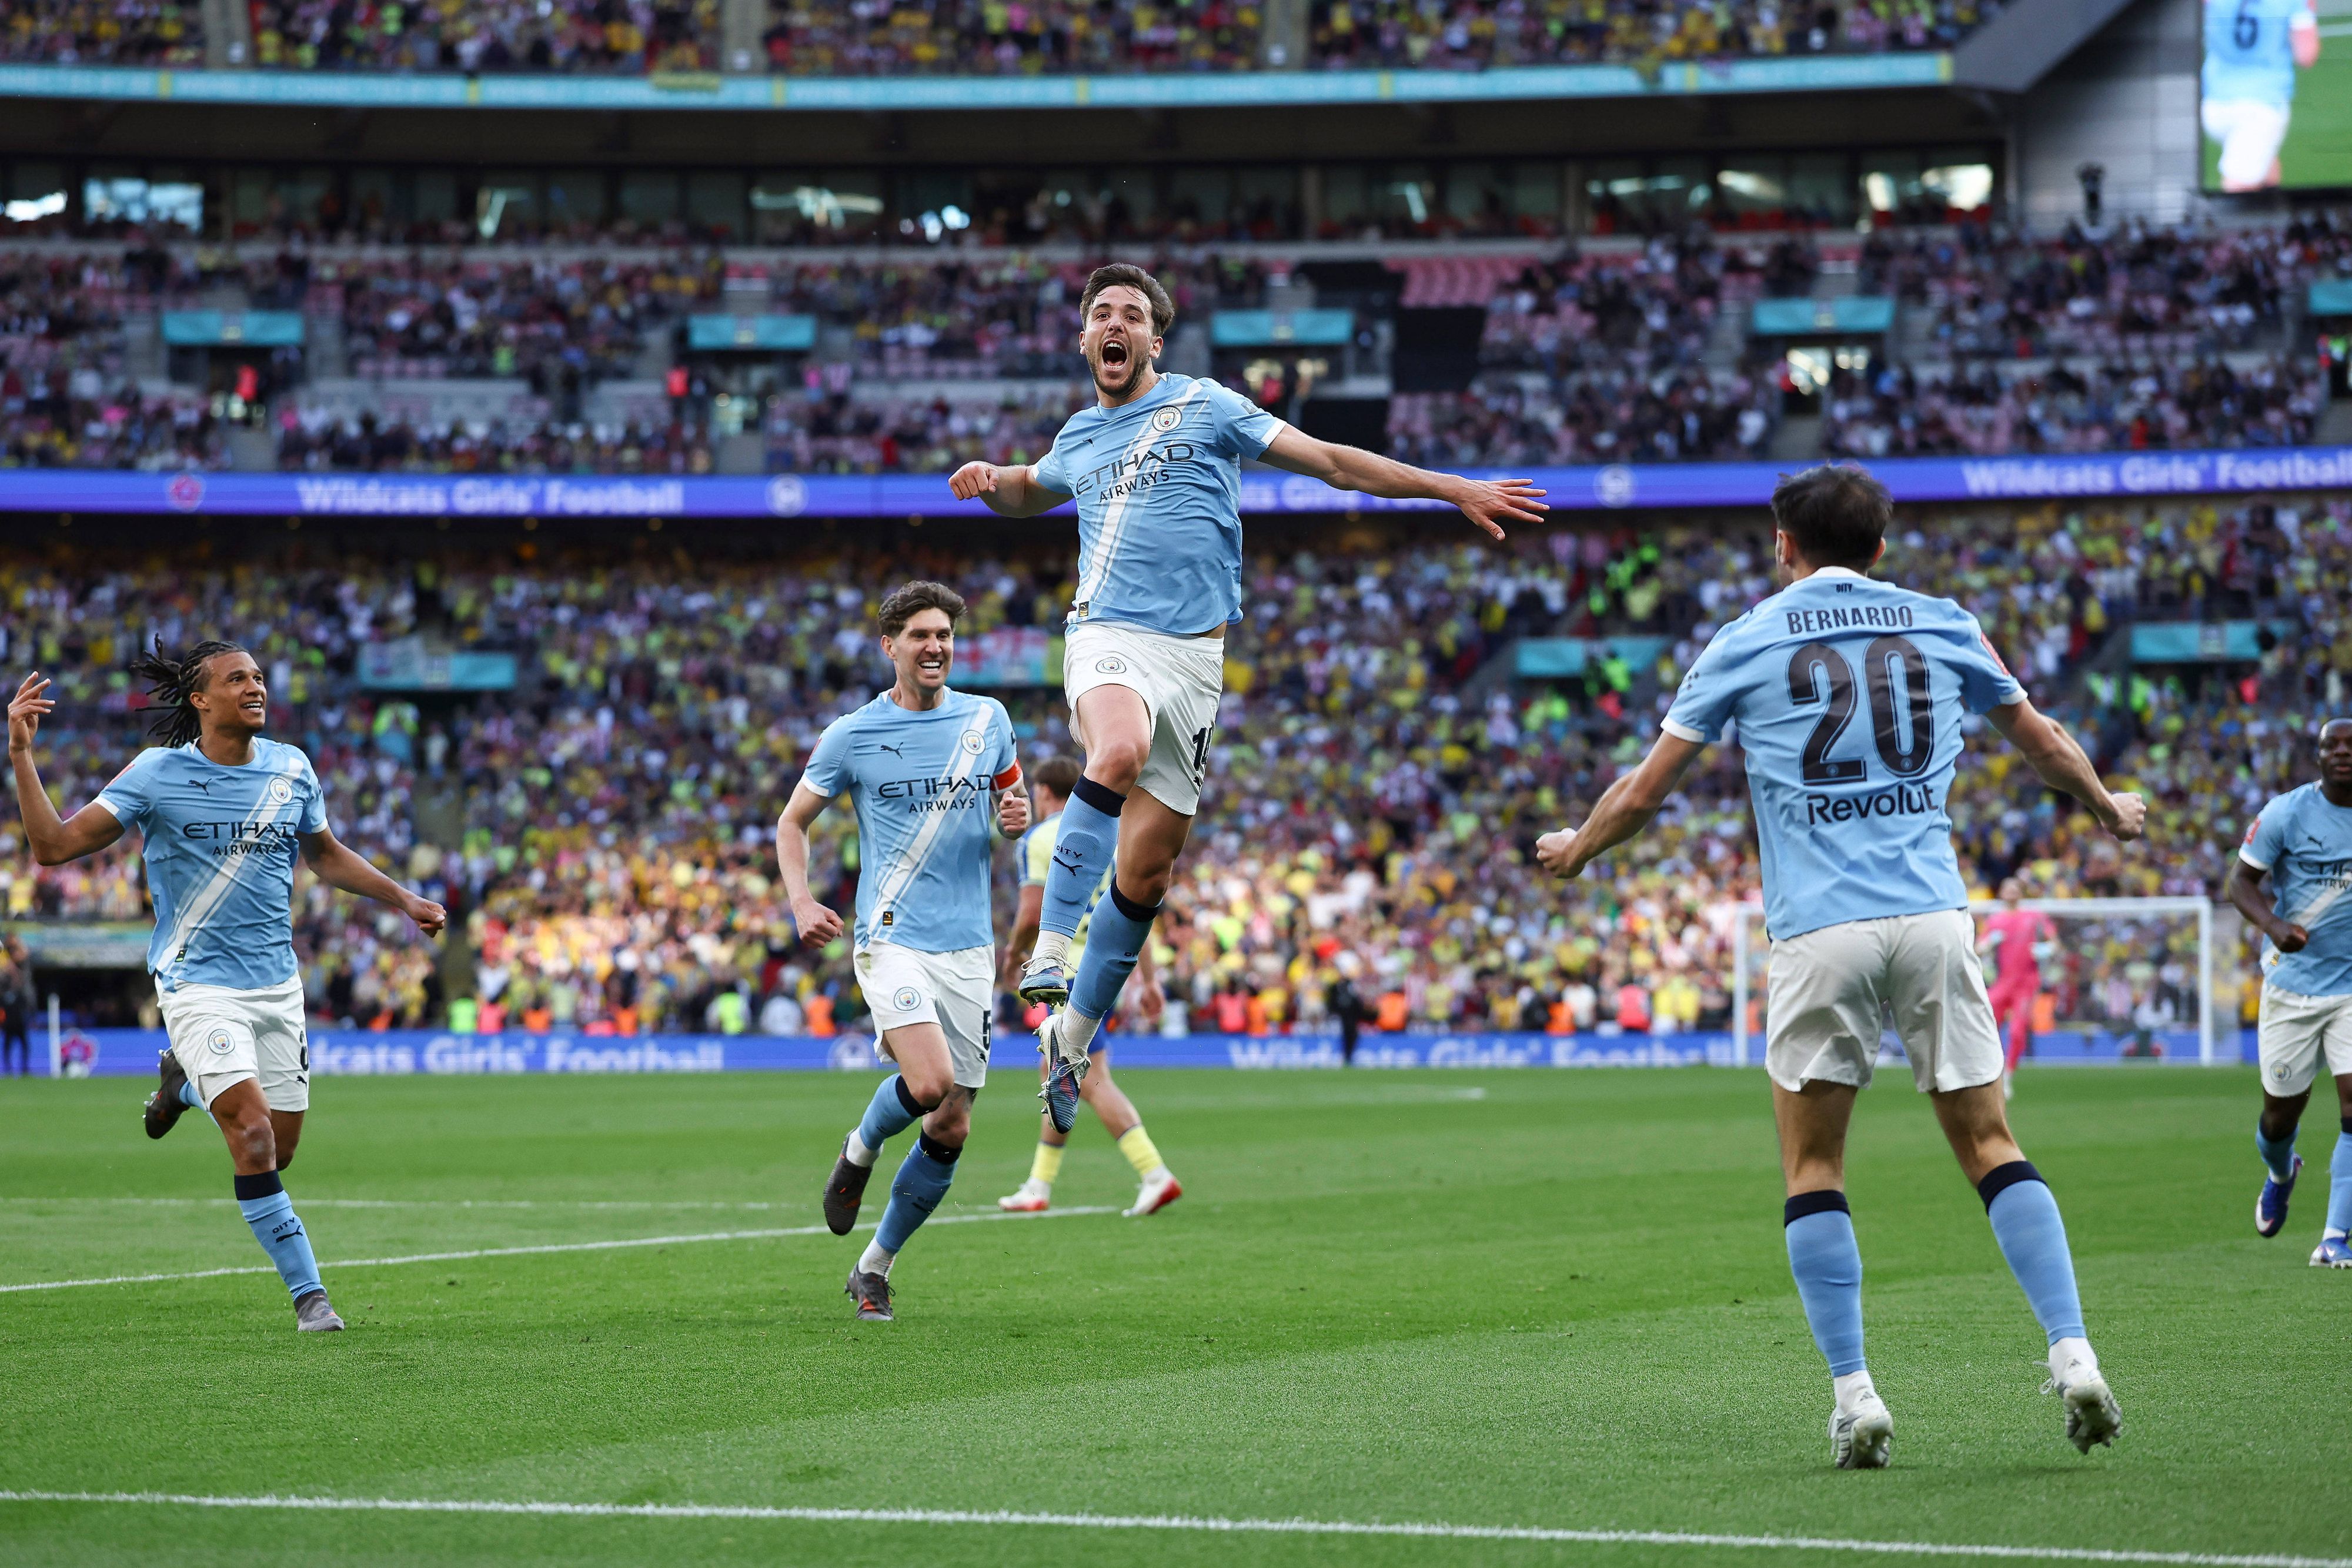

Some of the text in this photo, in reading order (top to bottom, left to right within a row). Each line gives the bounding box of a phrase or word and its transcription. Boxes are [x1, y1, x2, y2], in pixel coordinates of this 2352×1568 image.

[1077, 443, 1194, 495] ETIHAD
[1962, 462, 2116, 494] Wildcats
[297, 479, 447, 511] Wildcats
[1099, 470, 1170, 503] AIRWAYS
[1787, 606, 1913, 634] BERNARDO
[1785, 635, 1933, 785] 20
[878, 774, 992, 798] ETIHAD
[908, 798, 975, 813] AIRWAYS
[1807, 785, 1938, 825] Revolut
[183, 821, 297, 839] ETIHAD
[212, 843, 278, 856] AIRWAYS
[311, 1037, 415, 1074] dcats
[546, 1038, 723, 1074] Football
